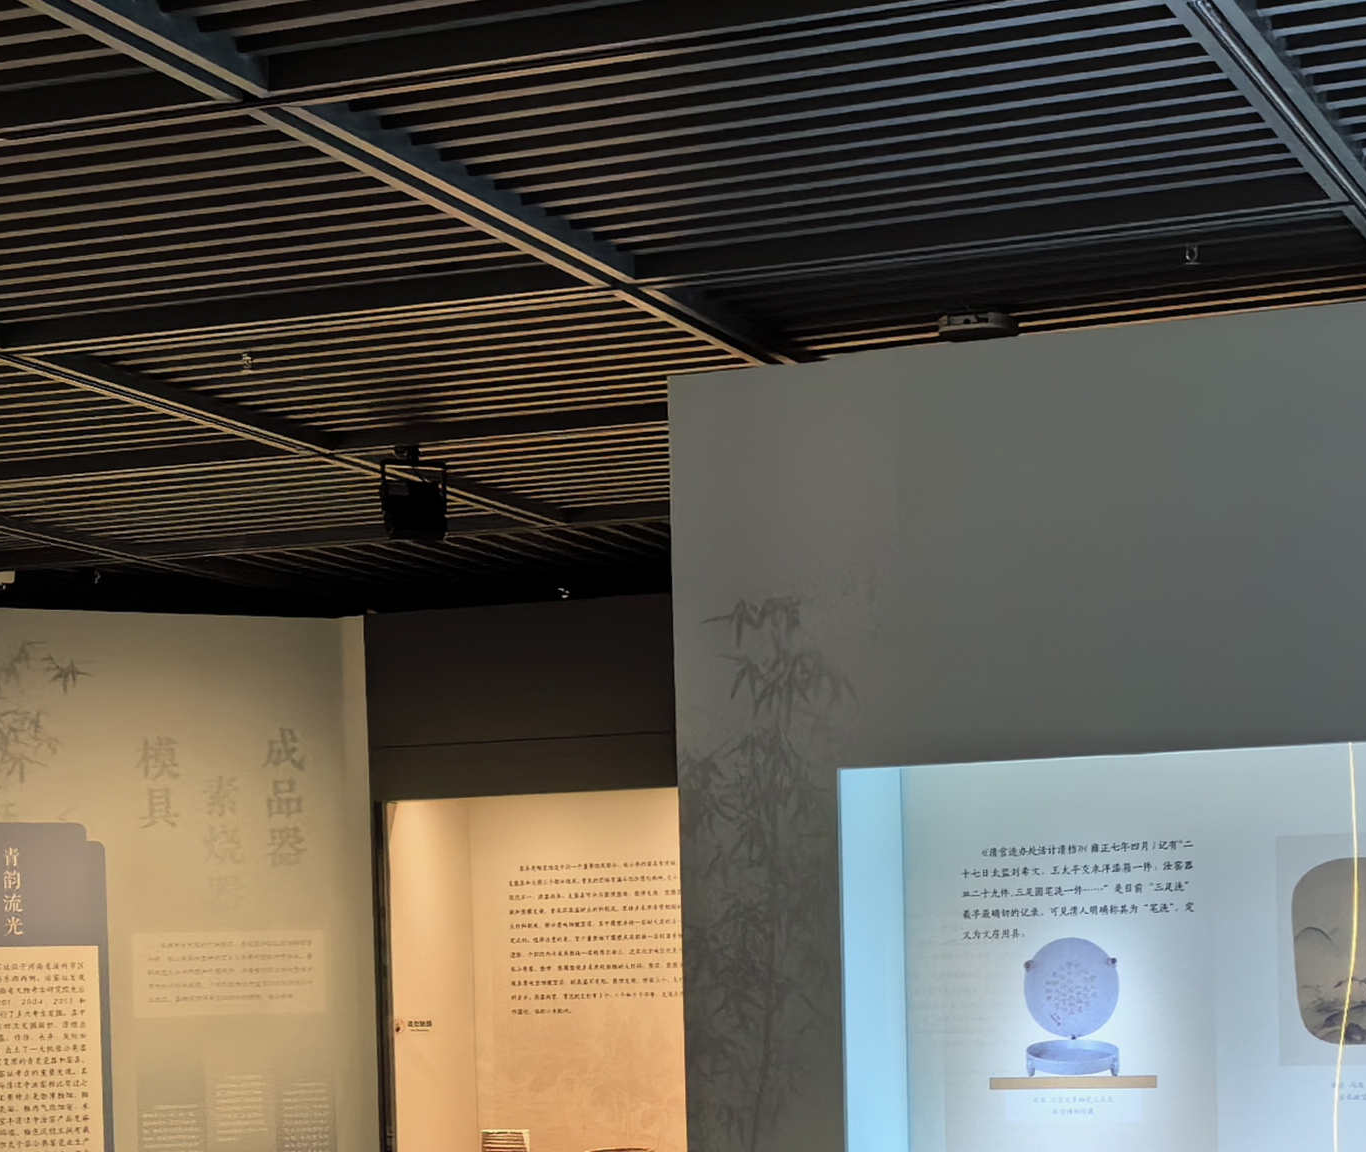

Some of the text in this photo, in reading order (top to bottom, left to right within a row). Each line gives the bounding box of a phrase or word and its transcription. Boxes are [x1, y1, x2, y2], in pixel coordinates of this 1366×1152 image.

[136, 736, 181, 829] 模具
[262, 728, 307, 868] 成品器
[2, 847, 24, 938] 青韵流光
